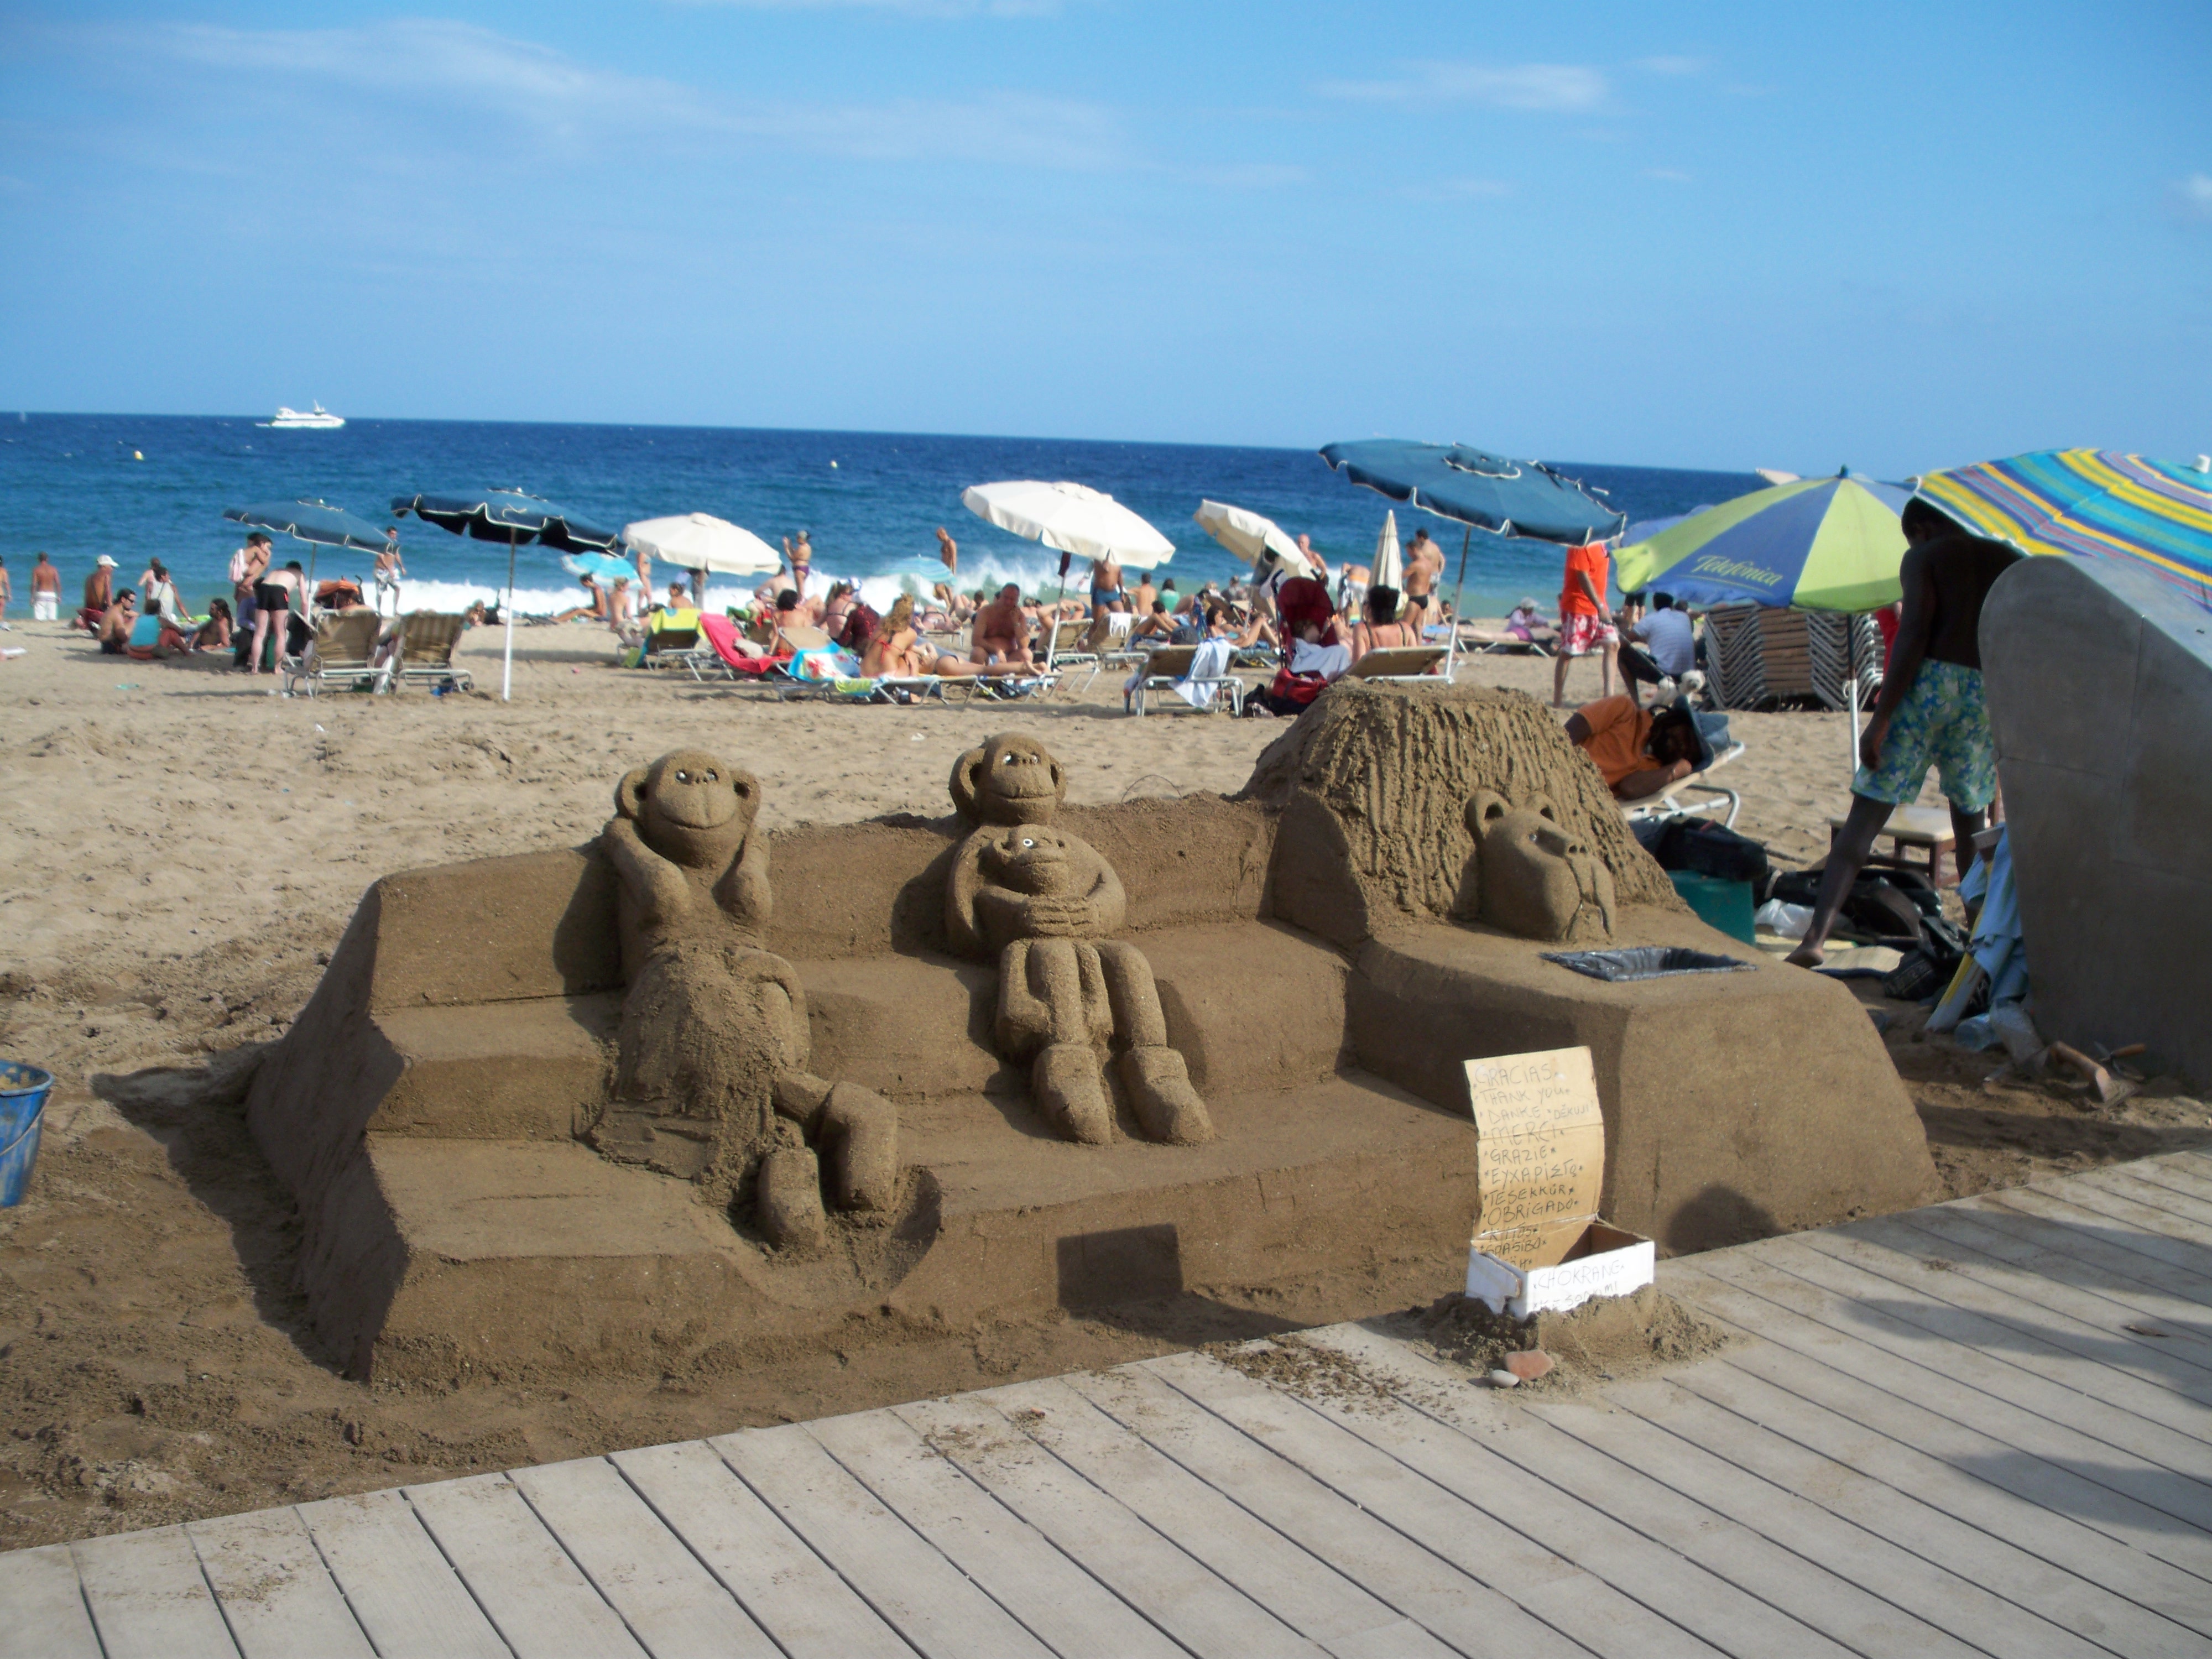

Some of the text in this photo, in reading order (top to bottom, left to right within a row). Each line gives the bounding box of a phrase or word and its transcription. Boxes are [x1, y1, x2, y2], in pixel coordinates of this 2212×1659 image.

[1480, 1088, 1530, 1105] THANK
[1488, 1107, 1541, 1124] DANKE
[1491, 1121, 1557, 1145] MERCI
[1490, 1146, 1547, 1165] GRAZIE
